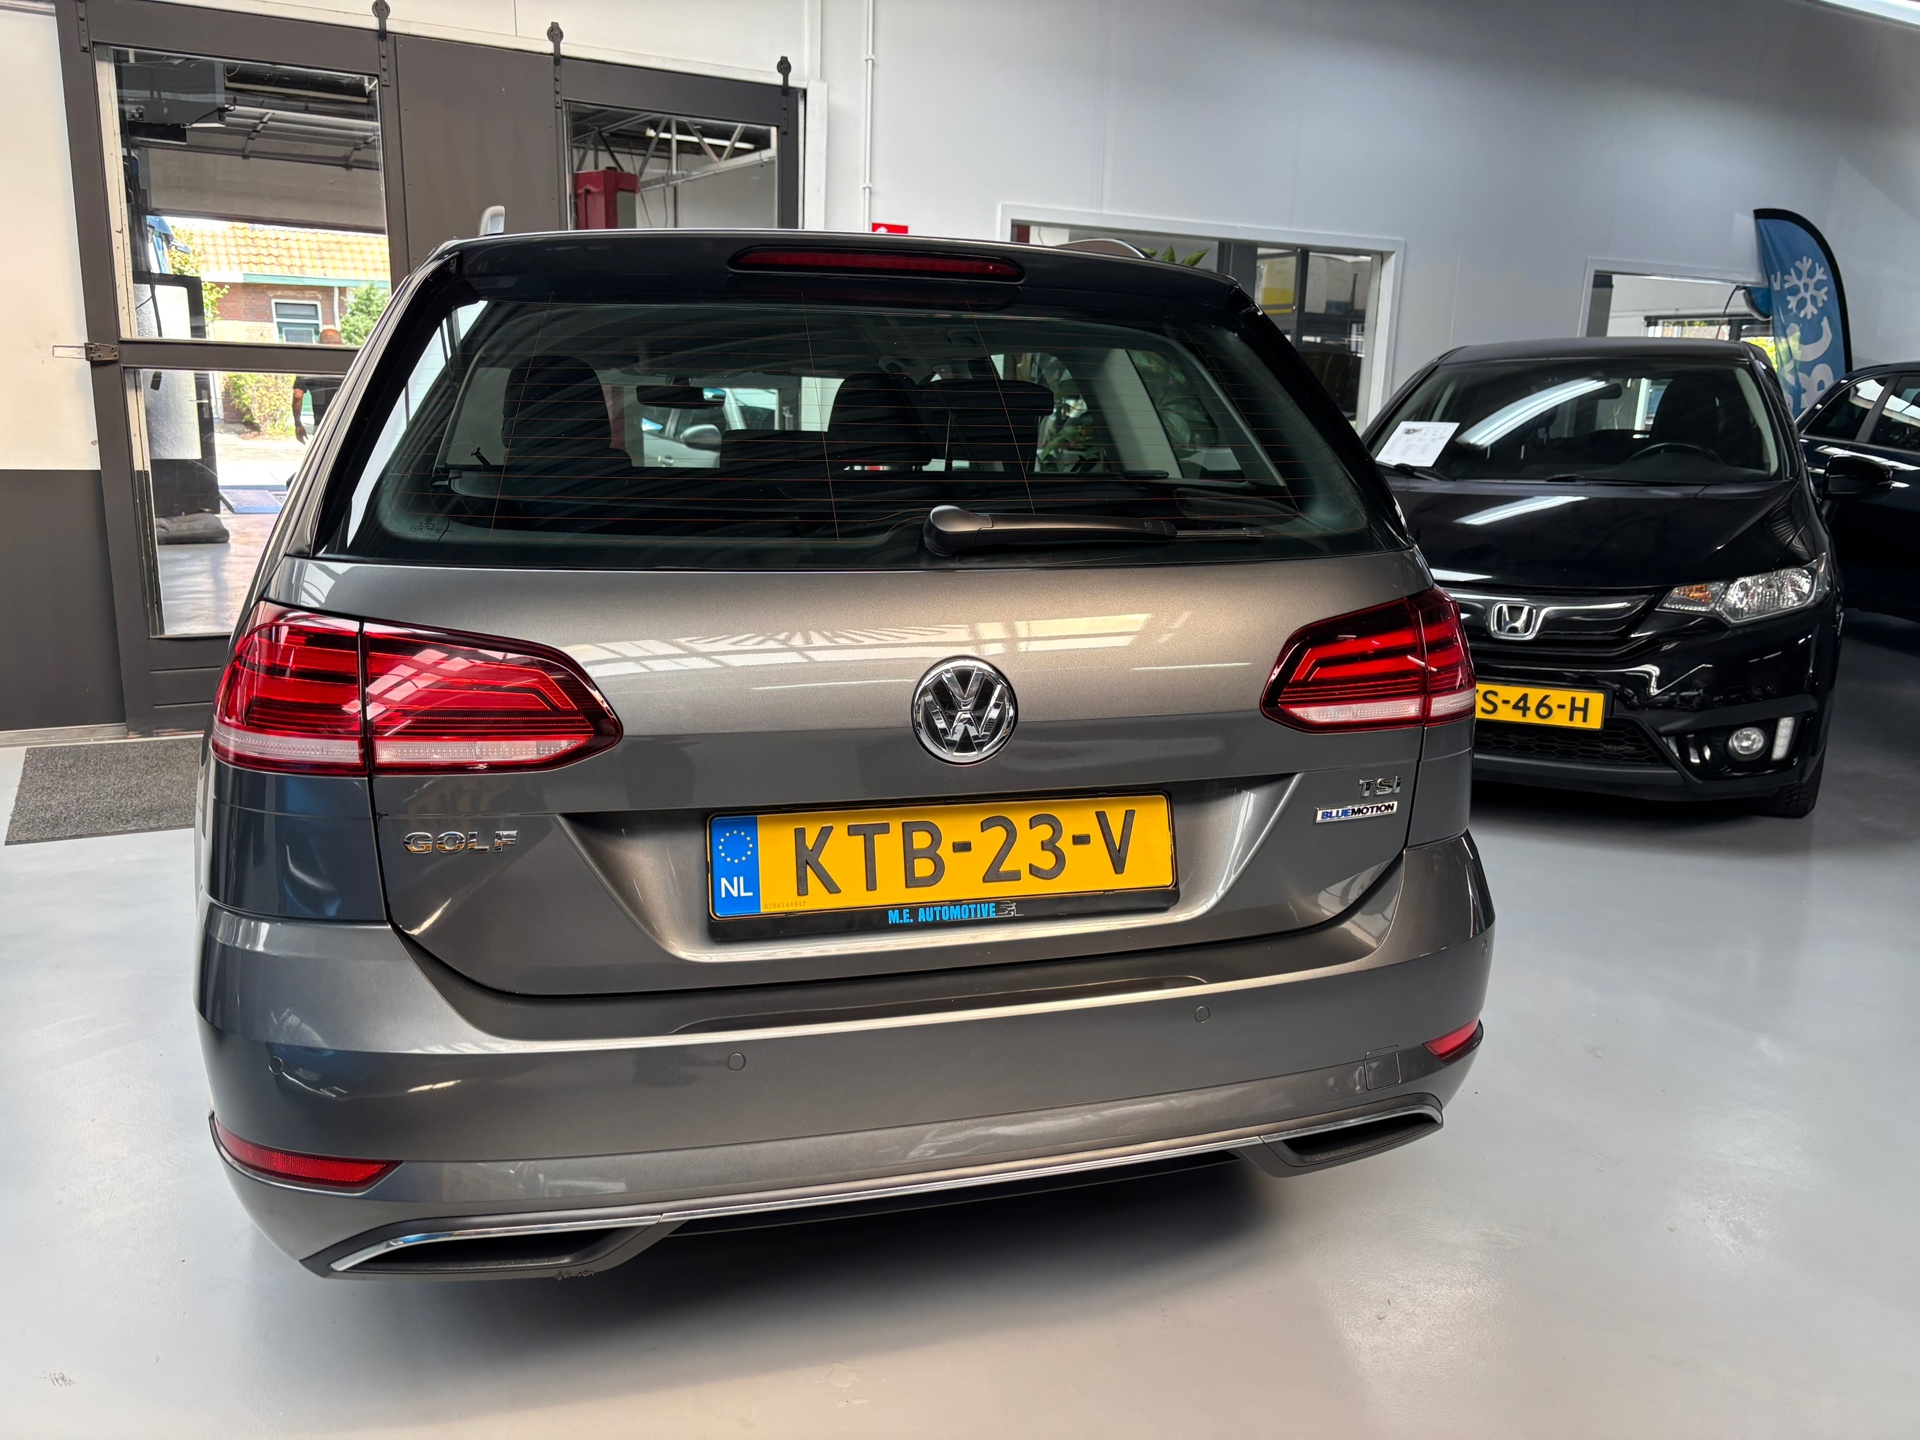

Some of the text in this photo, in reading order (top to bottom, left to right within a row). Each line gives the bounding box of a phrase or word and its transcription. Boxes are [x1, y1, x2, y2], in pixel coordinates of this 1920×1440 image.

[1476, 689, 1590, 723] S-46-H
[1358, 776, 1401, 797] TSI
[1321, 803, 1395, 820] BLUEMOTION
[403, 830, 518, 854] GOLF
[794, 809, 1135, 898] KTB-23-V
[720, 876, 753, 898] NL
[888, 902, 996, 924] M.E. AUTOMOTIVE
